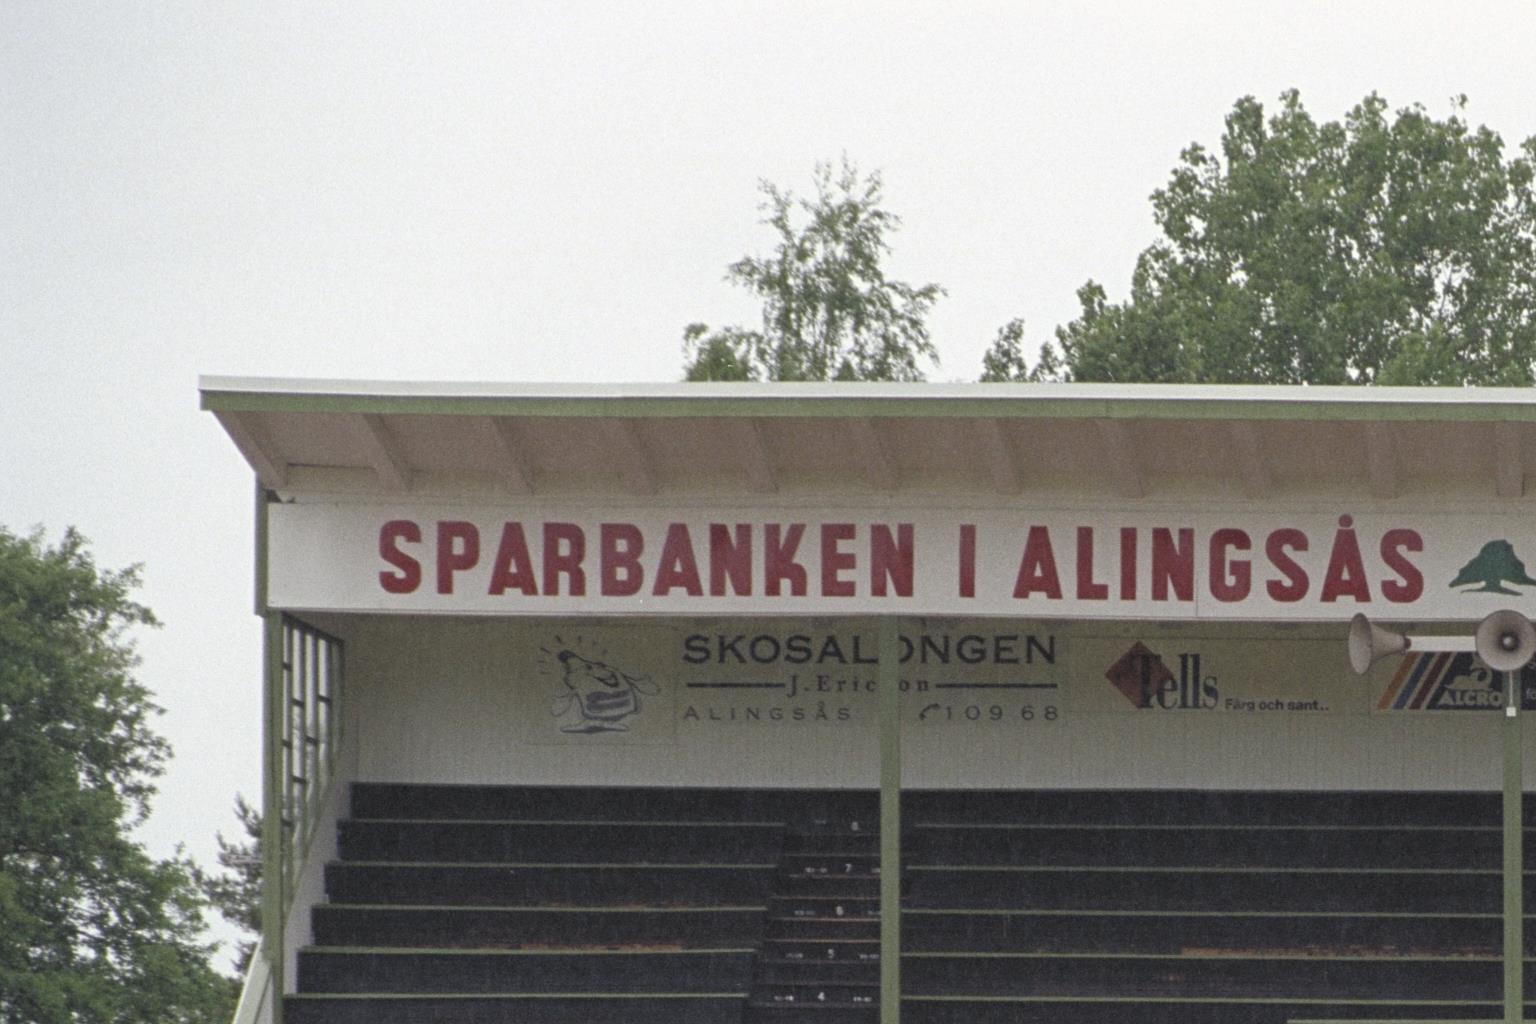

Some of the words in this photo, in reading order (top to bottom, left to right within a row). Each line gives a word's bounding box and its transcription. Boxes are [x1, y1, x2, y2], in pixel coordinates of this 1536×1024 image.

[379, 520, 914, 597] SPARBANKEN
[959, 524, 976, 598] I
[1013, 514, 1424, 603] ALINGSÅS
[786, 675, 929, 698] J.Ericon
[1126, 653, 1219, 710] Tells
[683, 701, 851, 721] ALINGSÅS
[1258, 698, 1284, 711] och
